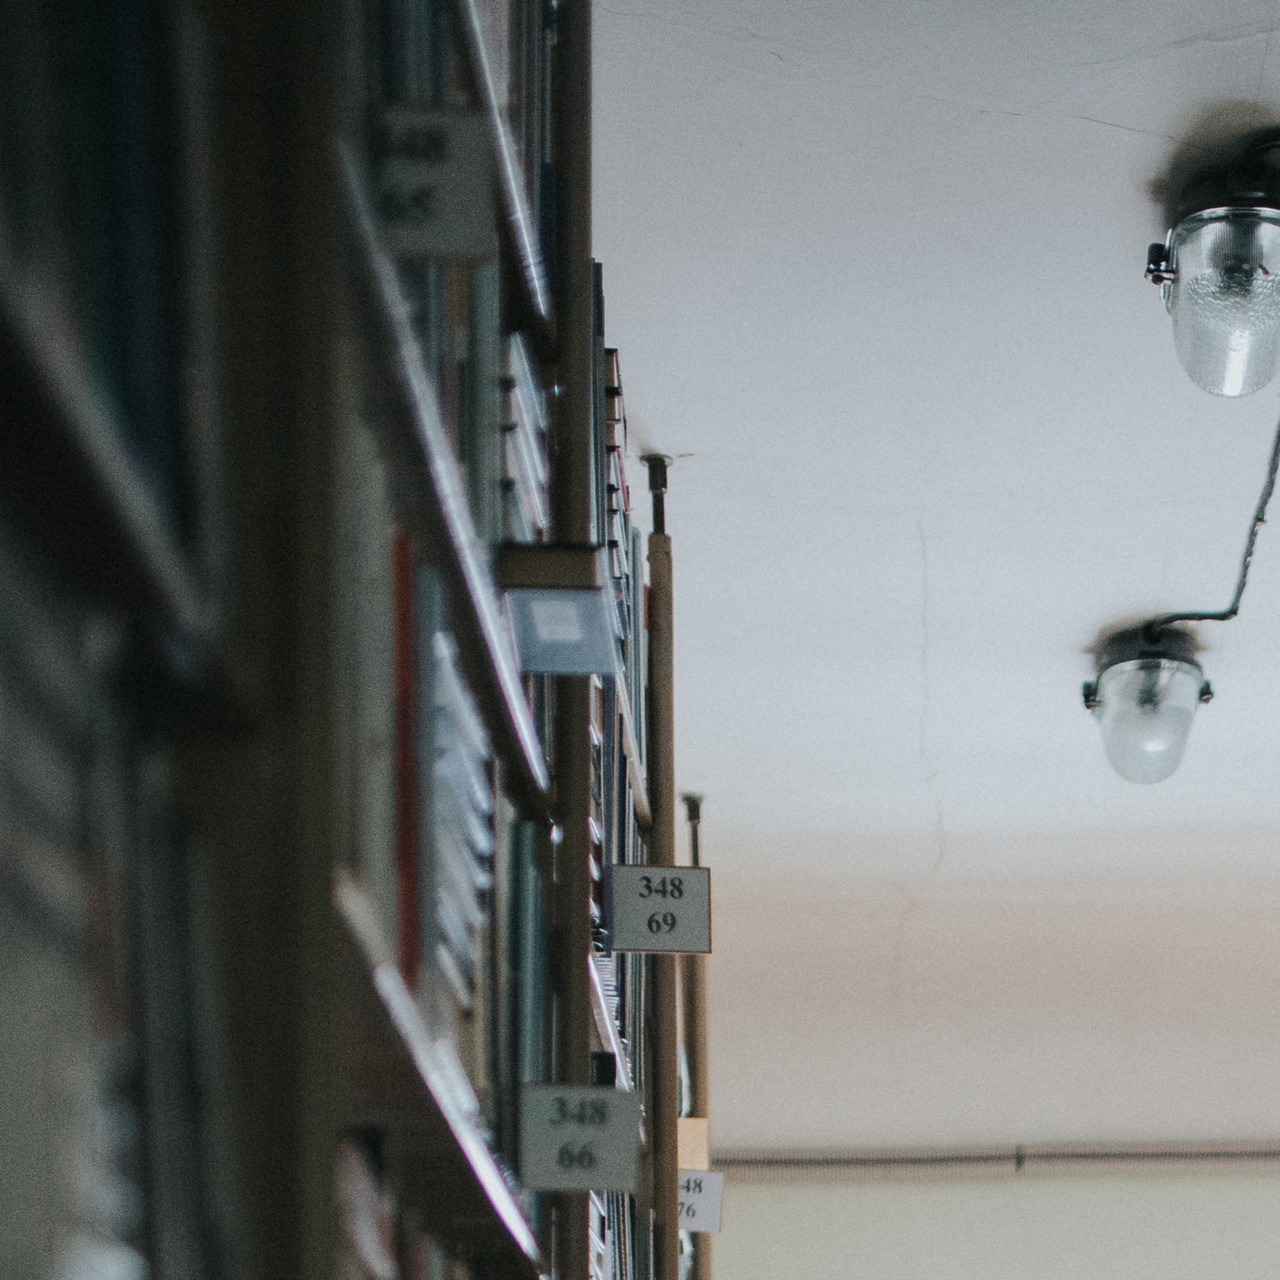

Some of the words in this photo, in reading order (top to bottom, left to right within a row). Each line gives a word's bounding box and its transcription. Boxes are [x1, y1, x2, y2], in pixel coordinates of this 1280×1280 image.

[638, 876, 684, 899] 348
[648, 911, 677, 934] 69
[549, 1098, 607, 1126] 348
[558, 1140, 595, 1169] 66
[679, 1177, 703, 1193] 48
